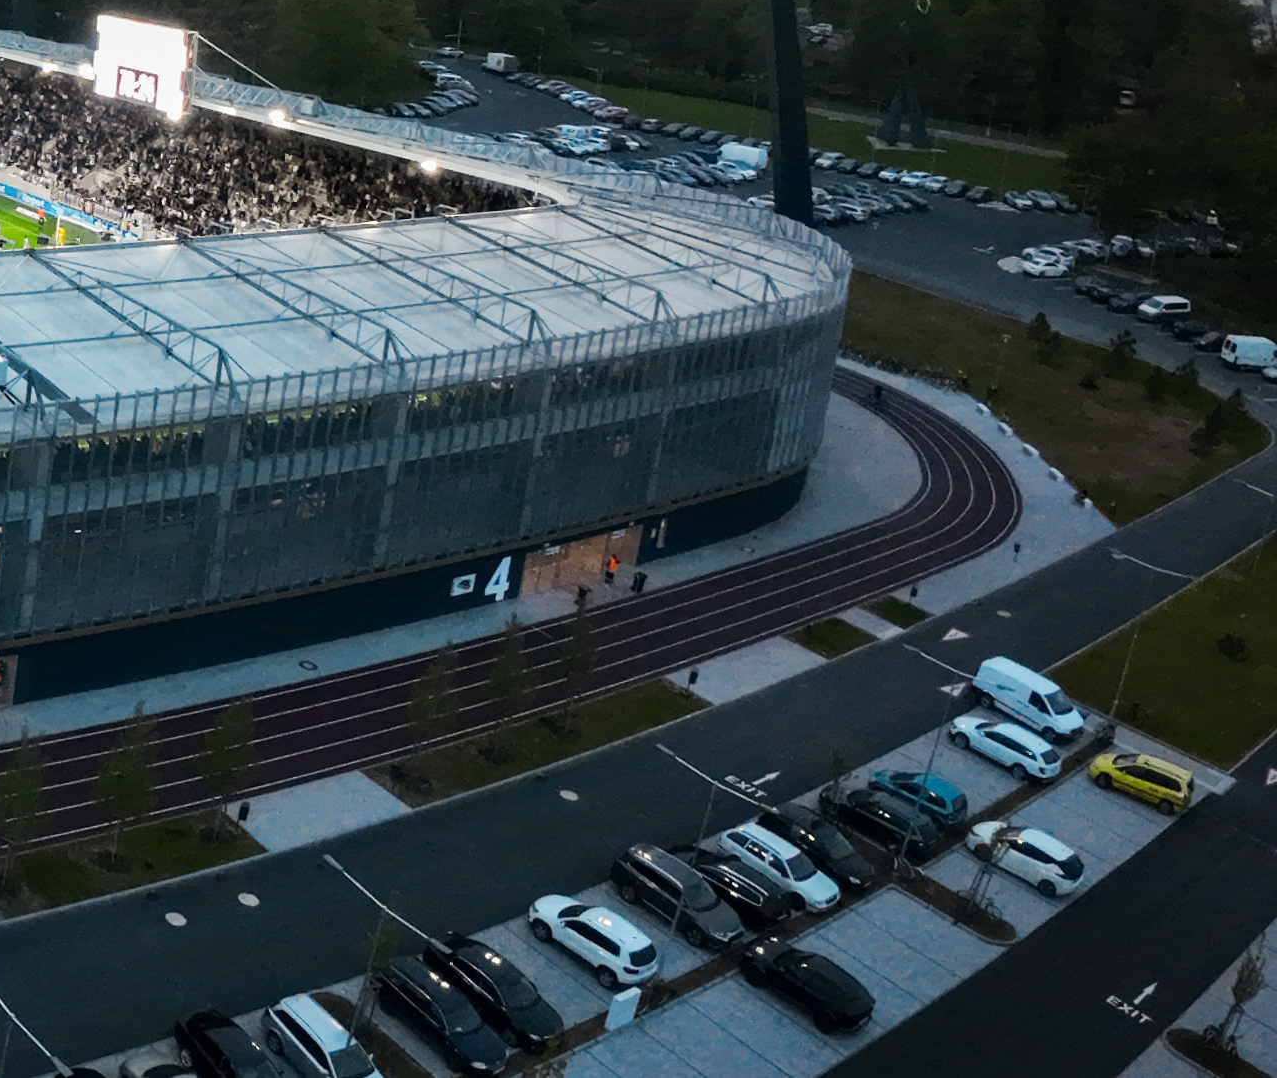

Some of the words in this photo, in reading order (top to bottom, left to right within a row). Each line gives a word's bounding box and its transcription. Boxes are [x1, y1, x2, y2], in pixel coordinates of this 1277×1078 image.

[484, 556, 512, 601] 4
[724, 775, 768, 798] EXIT
[1105, 995, 1154, 1023] EXIT
